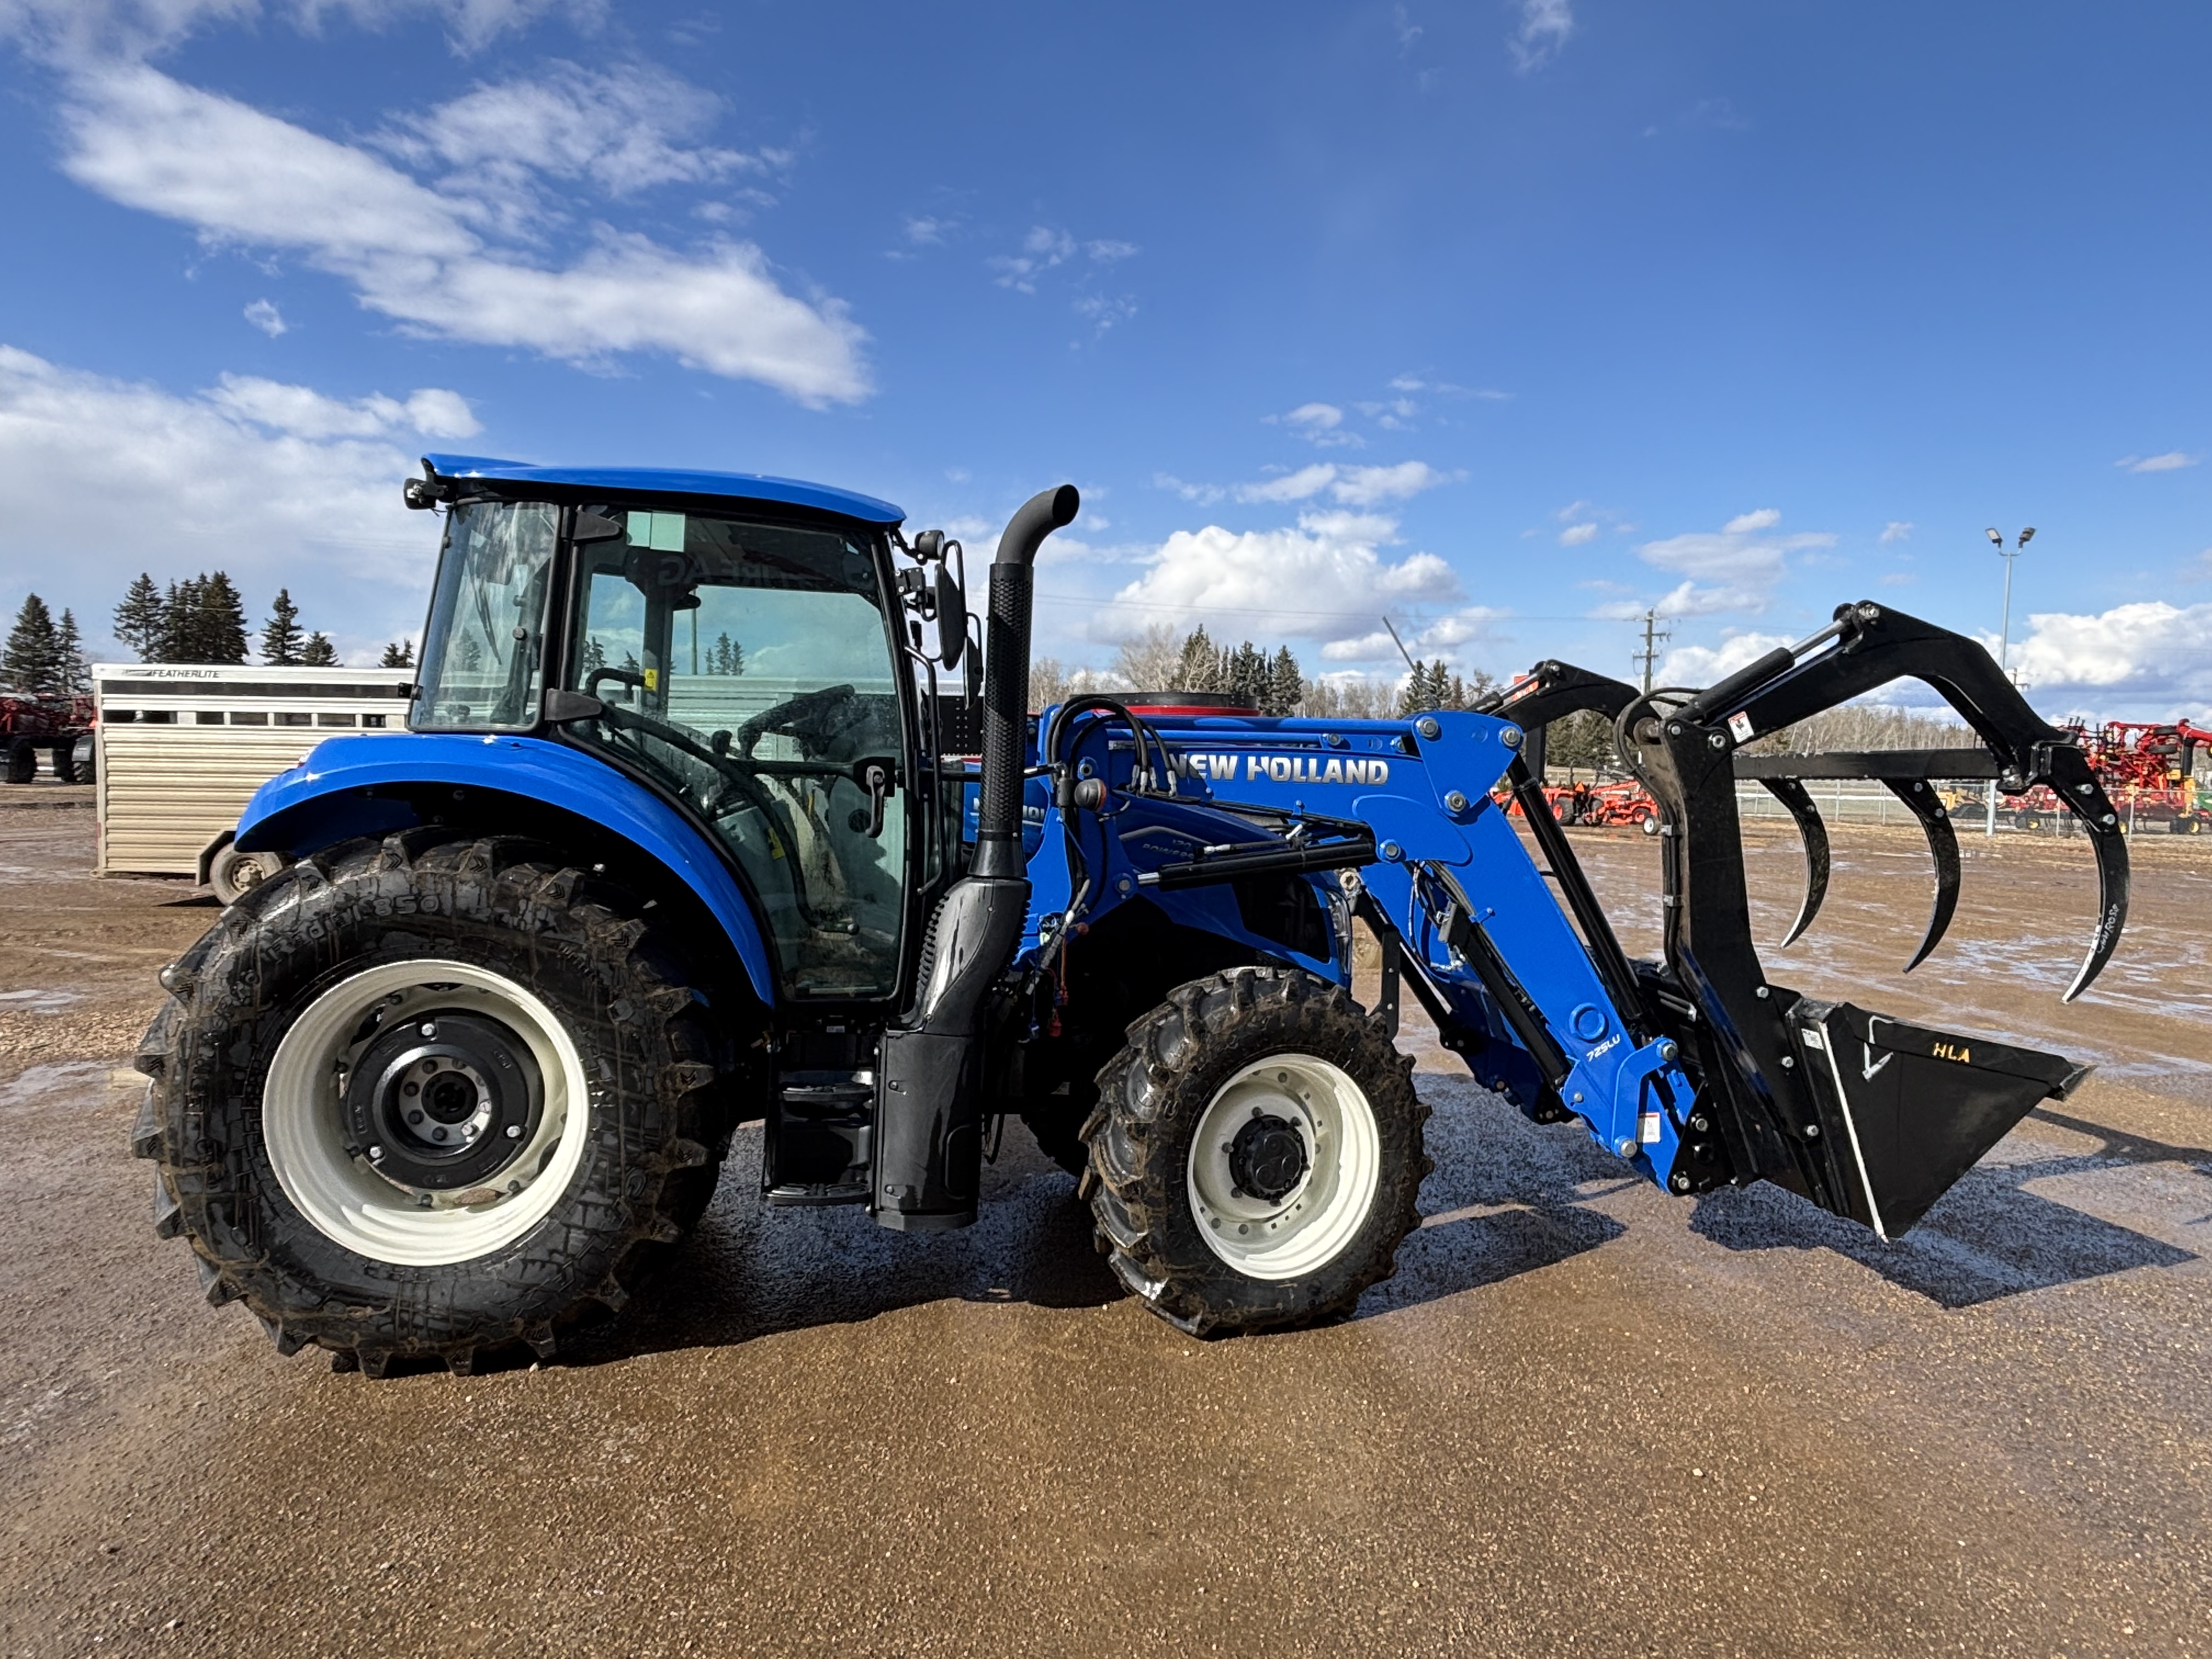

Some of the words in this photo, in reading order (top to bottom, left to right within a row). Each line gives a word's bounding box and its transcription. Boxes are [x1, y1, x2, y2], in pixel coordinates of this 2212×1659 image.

[153, 669, 219, 678] FEATHERLITE
[1169, 753, 1238, 780] NEW
[1247, 756, 1389, 786] HOLLAND
[1586, 1034, 1621, 1062] 725LU
[1932, 1042, 1970, 1063] HLA
